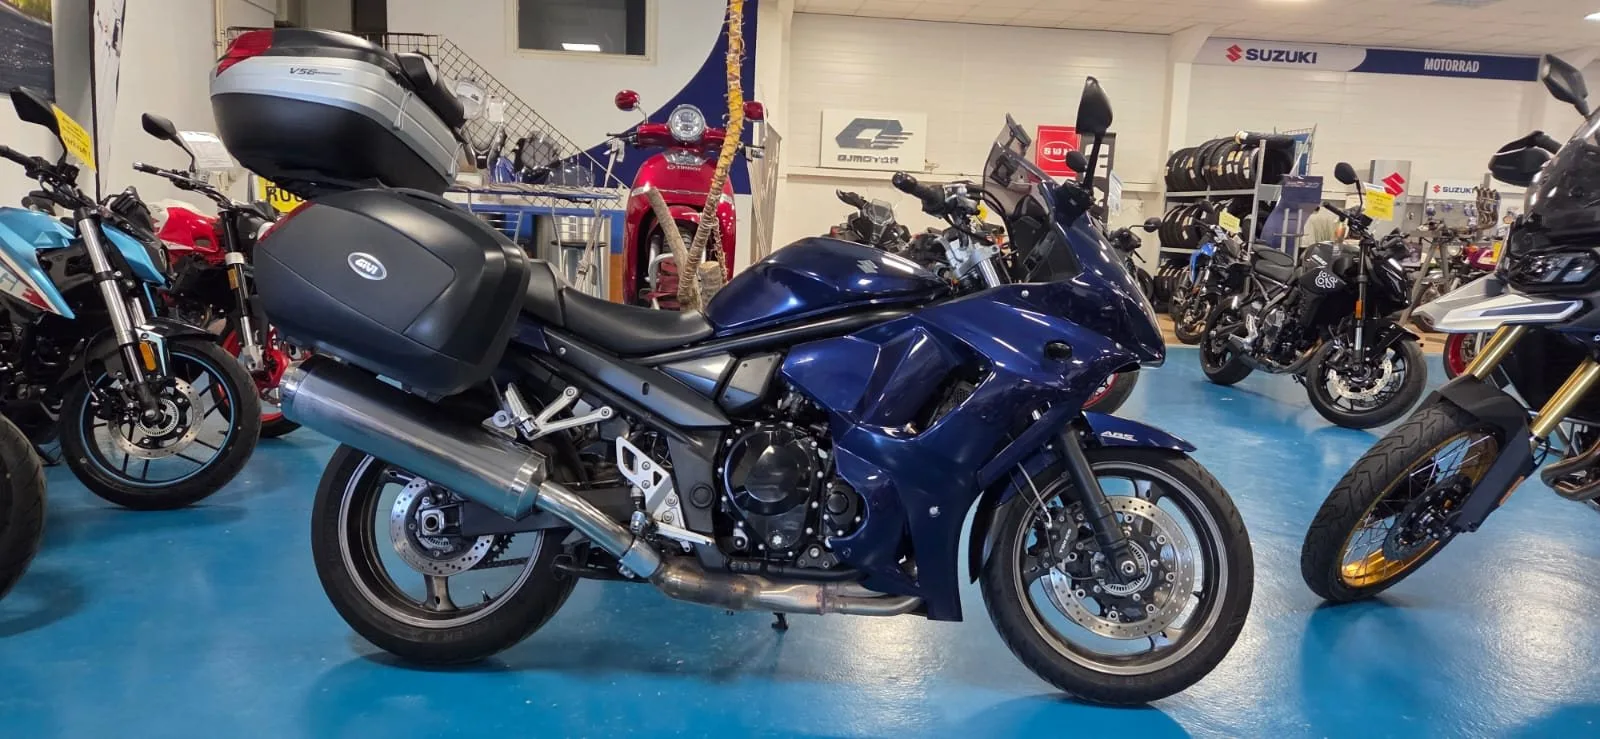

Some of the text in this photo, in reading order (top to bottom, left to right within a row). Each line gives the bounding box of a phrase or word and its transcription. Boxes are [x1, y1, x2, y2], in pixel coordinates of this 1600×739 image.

[1246, 48, 1317, 64] SUZUKI
[1424, 58, 1480, 72] MOTORRAD
[355, 258, 379, 275] GIVI
[1100, 430, 1137, 441] ABS
